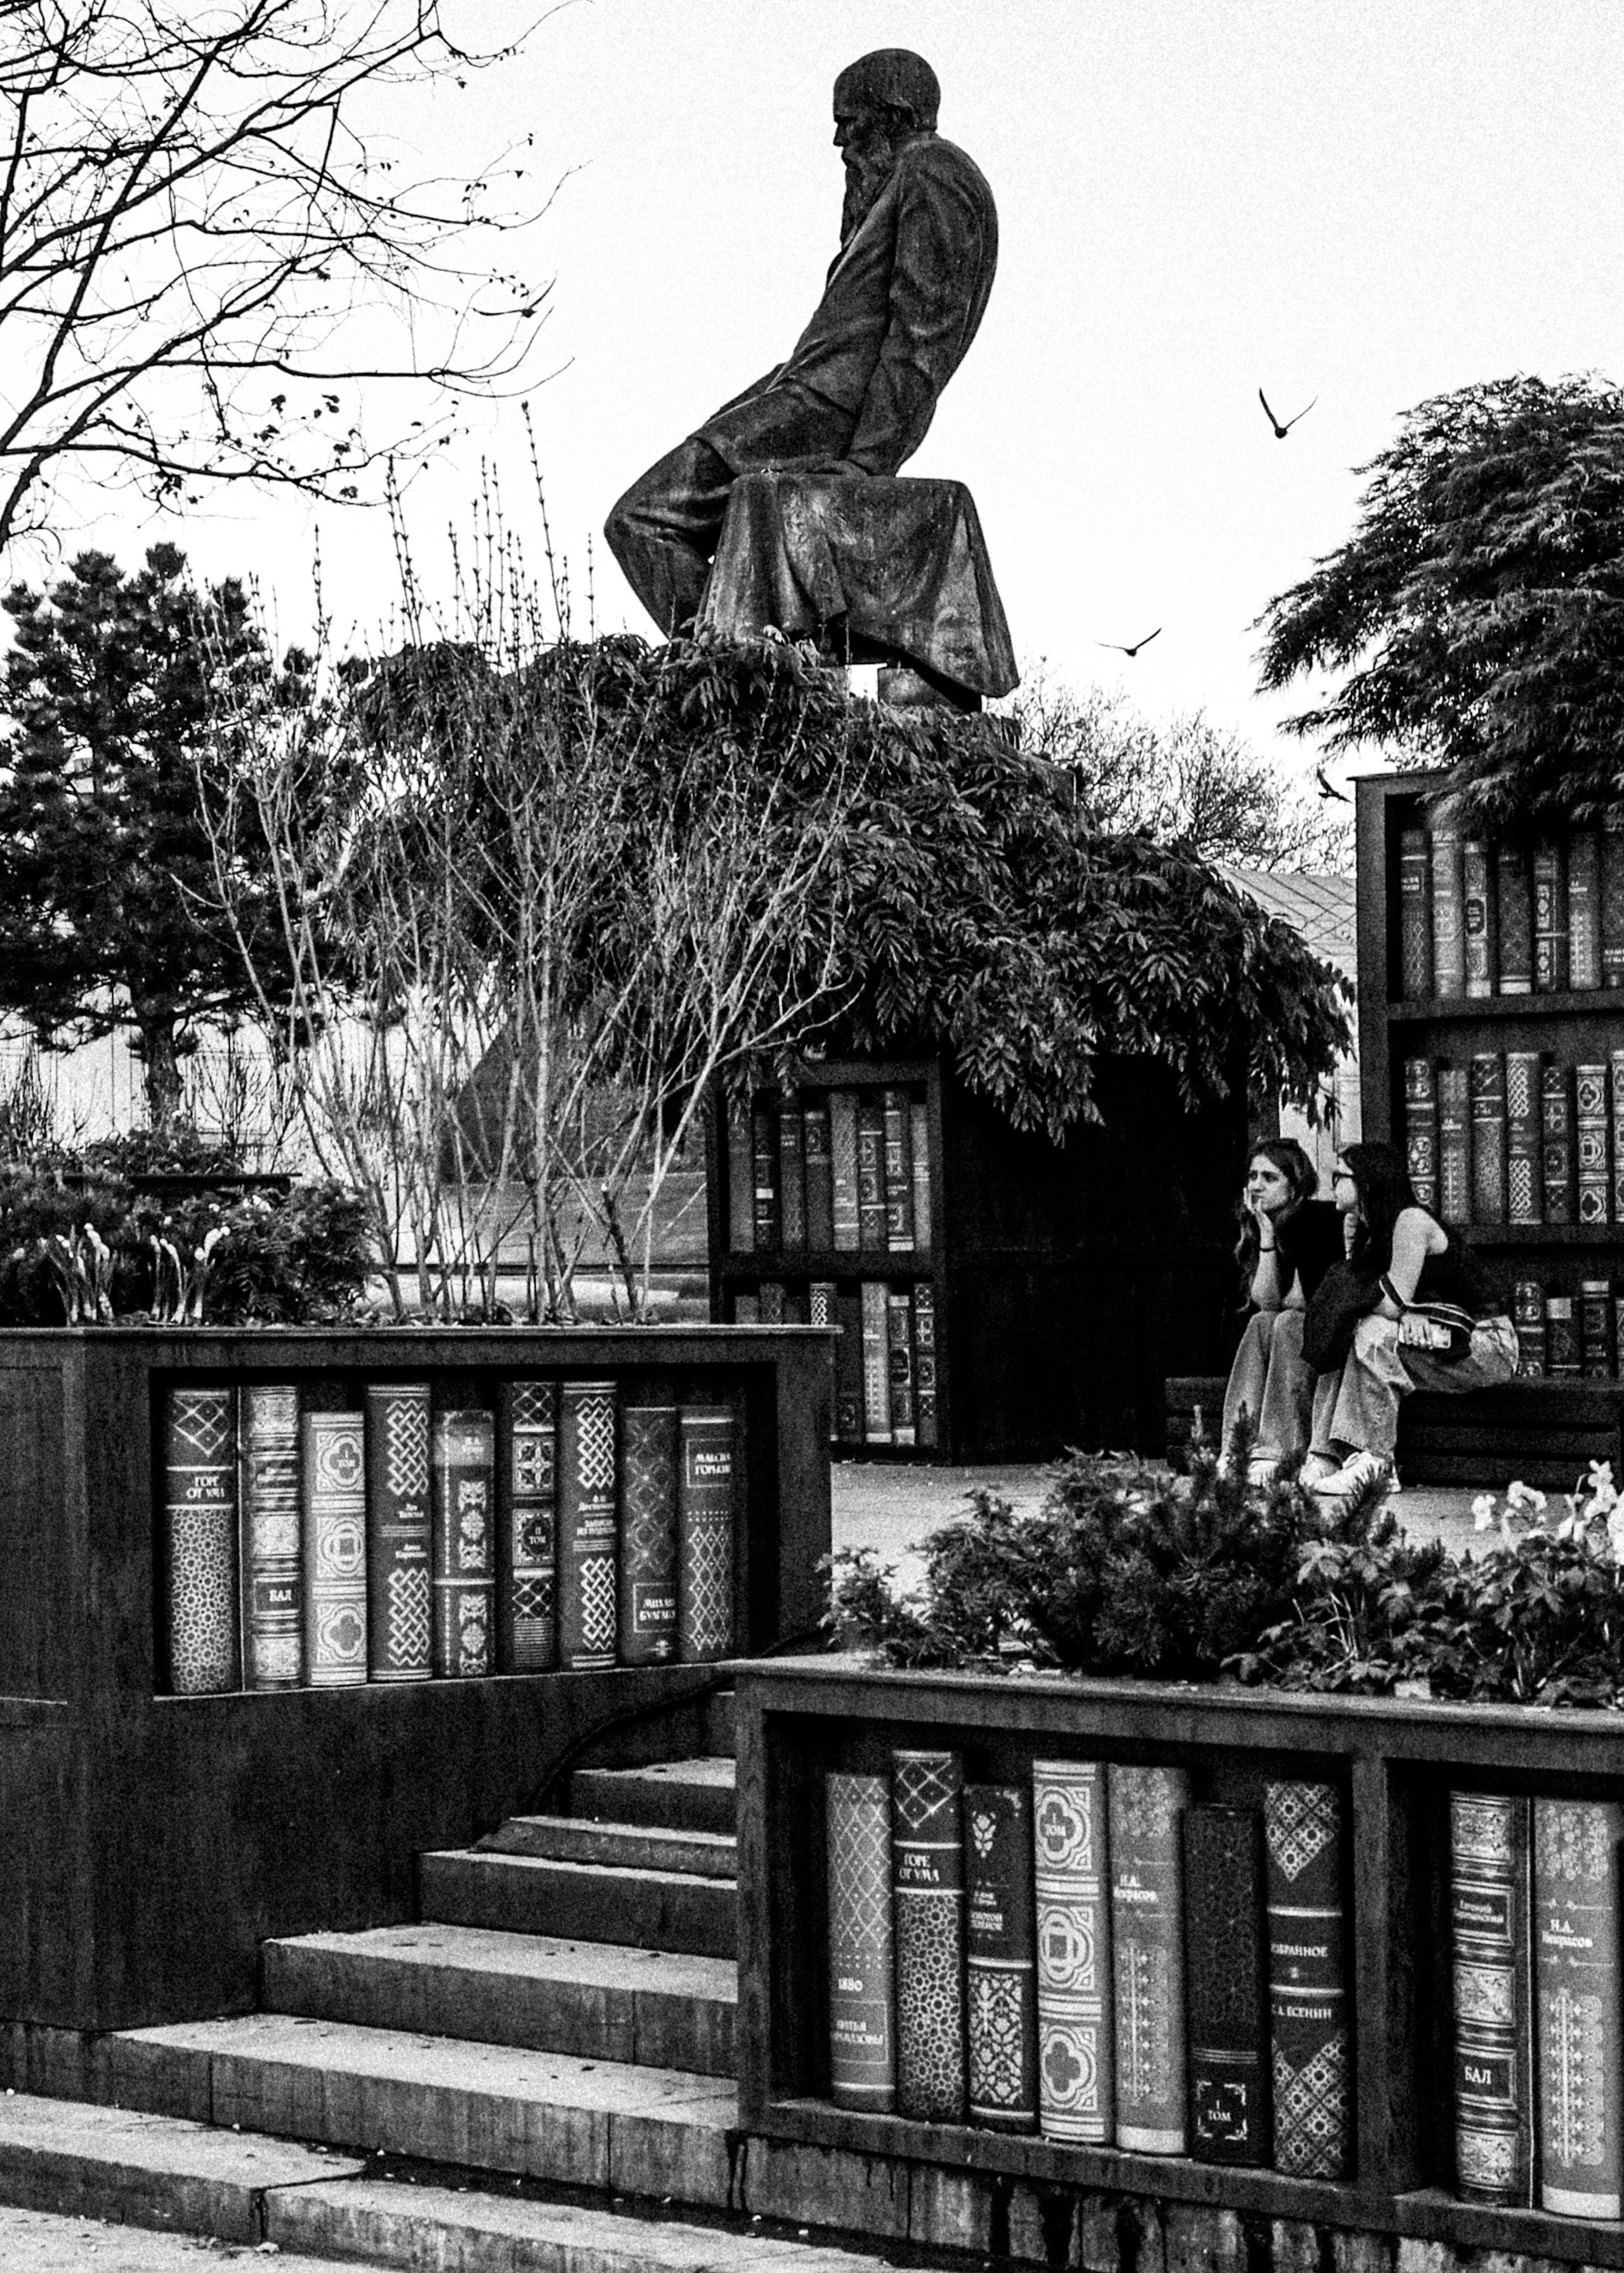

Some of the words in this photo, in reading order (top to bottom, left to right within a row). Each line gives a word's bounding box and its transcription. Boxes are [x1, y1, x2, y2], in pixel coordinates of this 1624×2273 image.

[186, 1488, 203, 1498] ОТ
[1045, 1823, 1066, 1837] ТОМ
[899, 1868, 912, 1880] ОТ
[1287, 2005, 1332, 2019] ЕСЕНИН
[1465, 2066, 1492, 2085] БАЛ
[1208, 2109, 1232, 2122] ТОМ
